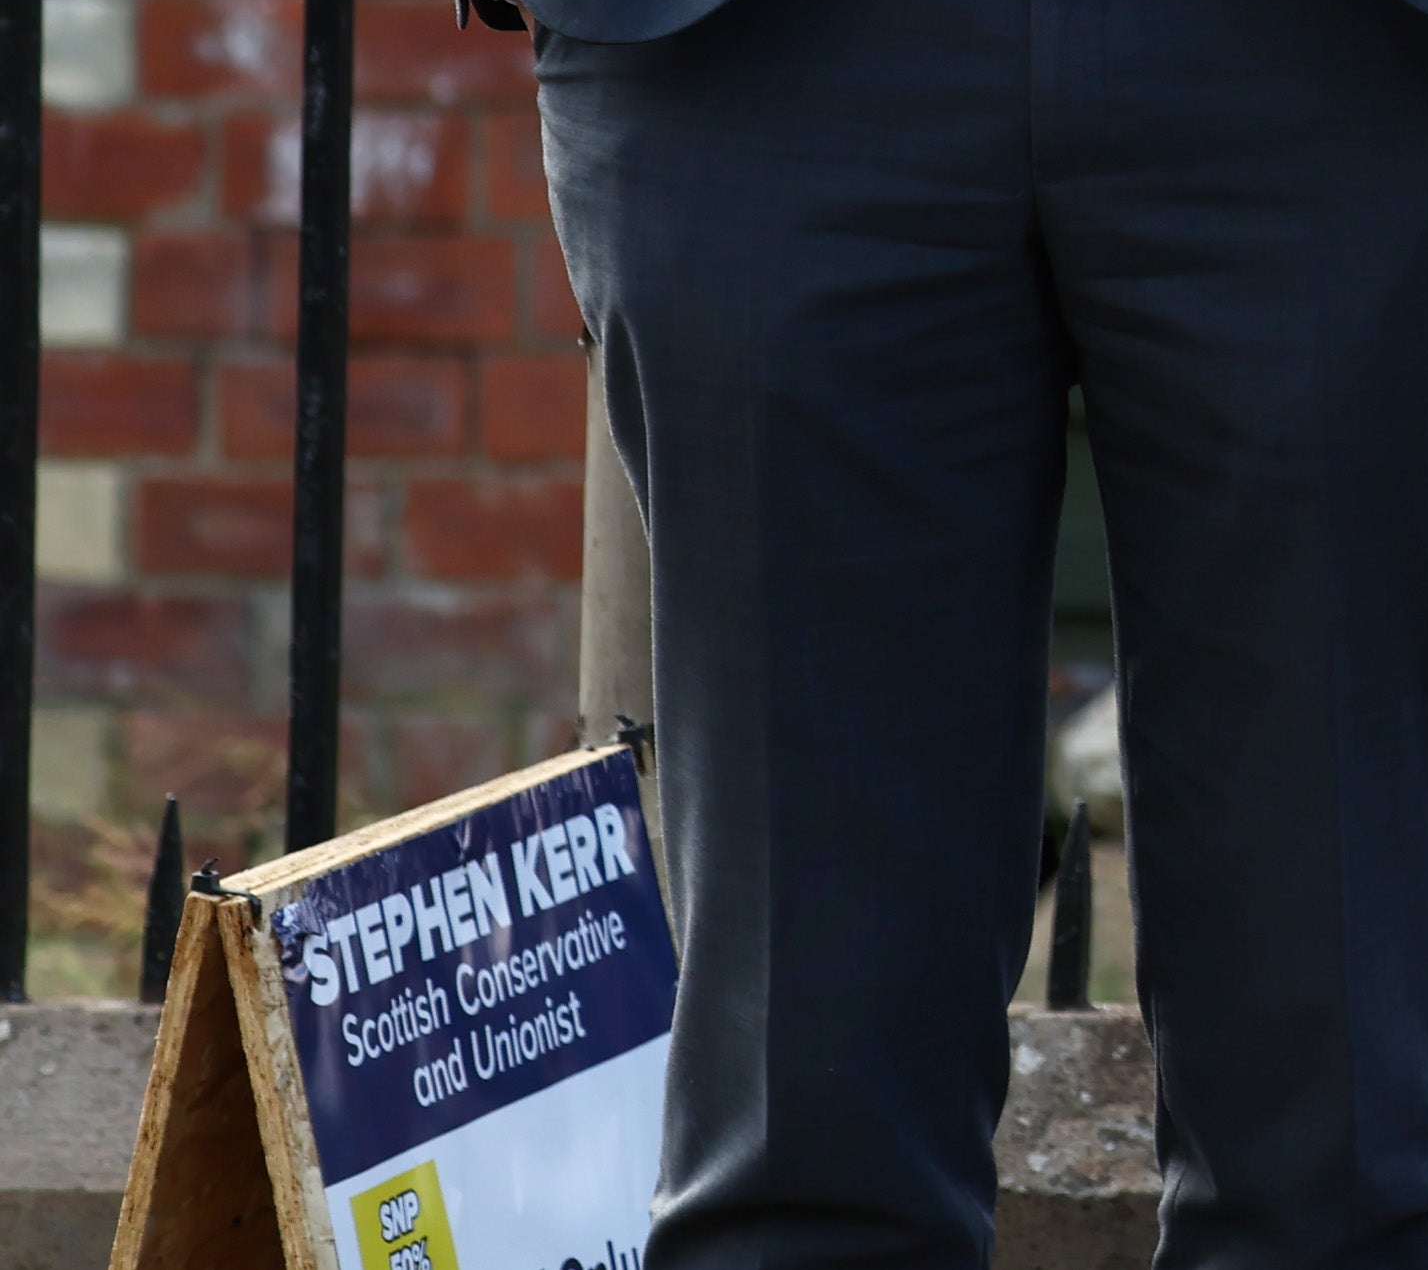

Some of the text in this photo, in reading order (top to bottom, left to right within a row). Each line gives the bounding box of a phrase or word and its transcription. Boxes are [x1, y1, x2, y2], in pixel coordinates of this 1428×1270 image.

[304, 802, 636, 1006] STEPHEN KERR
[342, 909, 628, 1067] Scottish Conservative
[413, 990, 587, 1108] and Unionist
[378, 1188, 420, 1243] SNP
